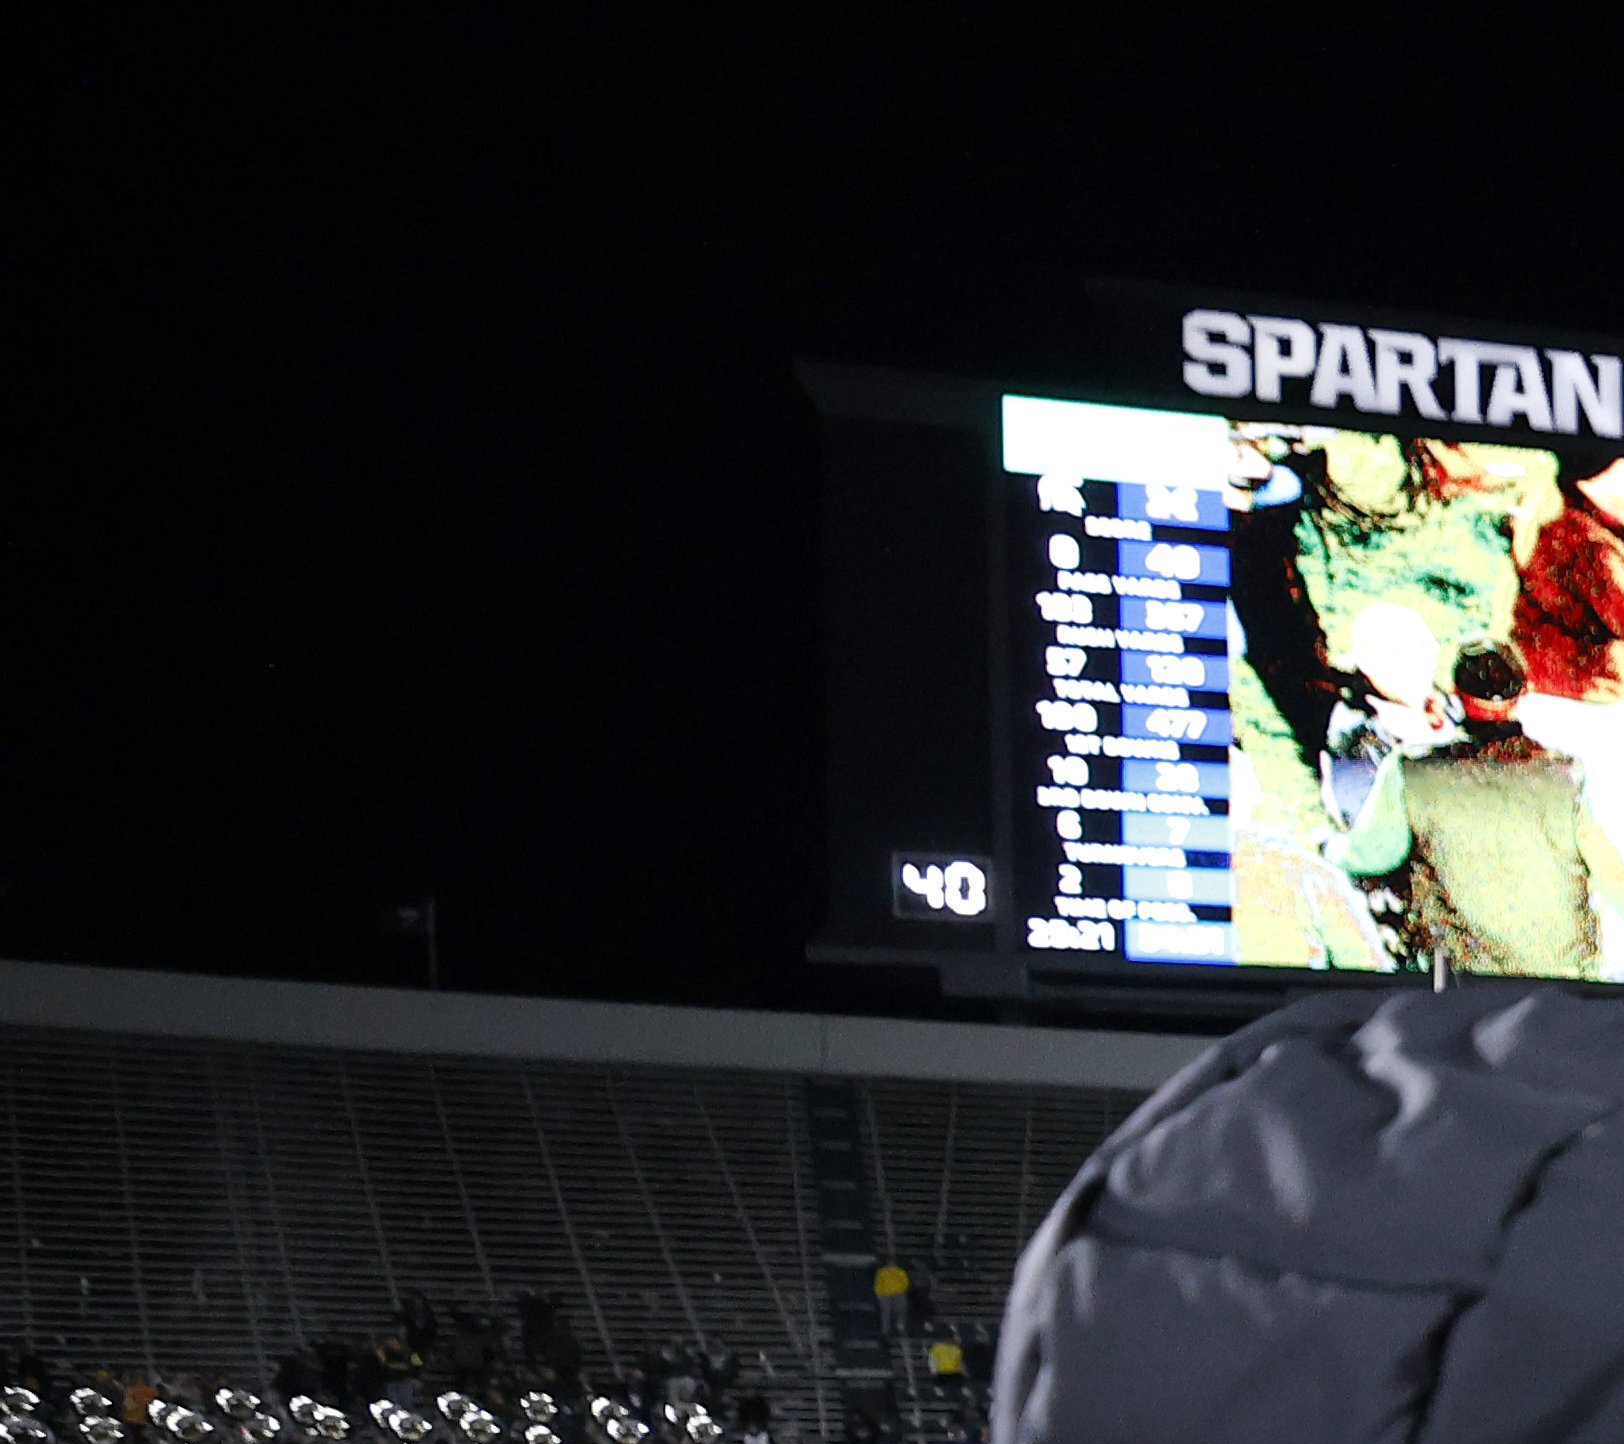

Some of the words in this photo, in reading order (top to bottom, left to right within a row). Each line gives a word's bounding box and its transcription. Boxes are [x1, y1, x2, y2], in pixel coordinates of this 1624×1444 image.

[1182, 308, 1624, 439] SPARTAN
[902, 861, 986, 915] 40
[1057, 863, 1083, 894] 2
